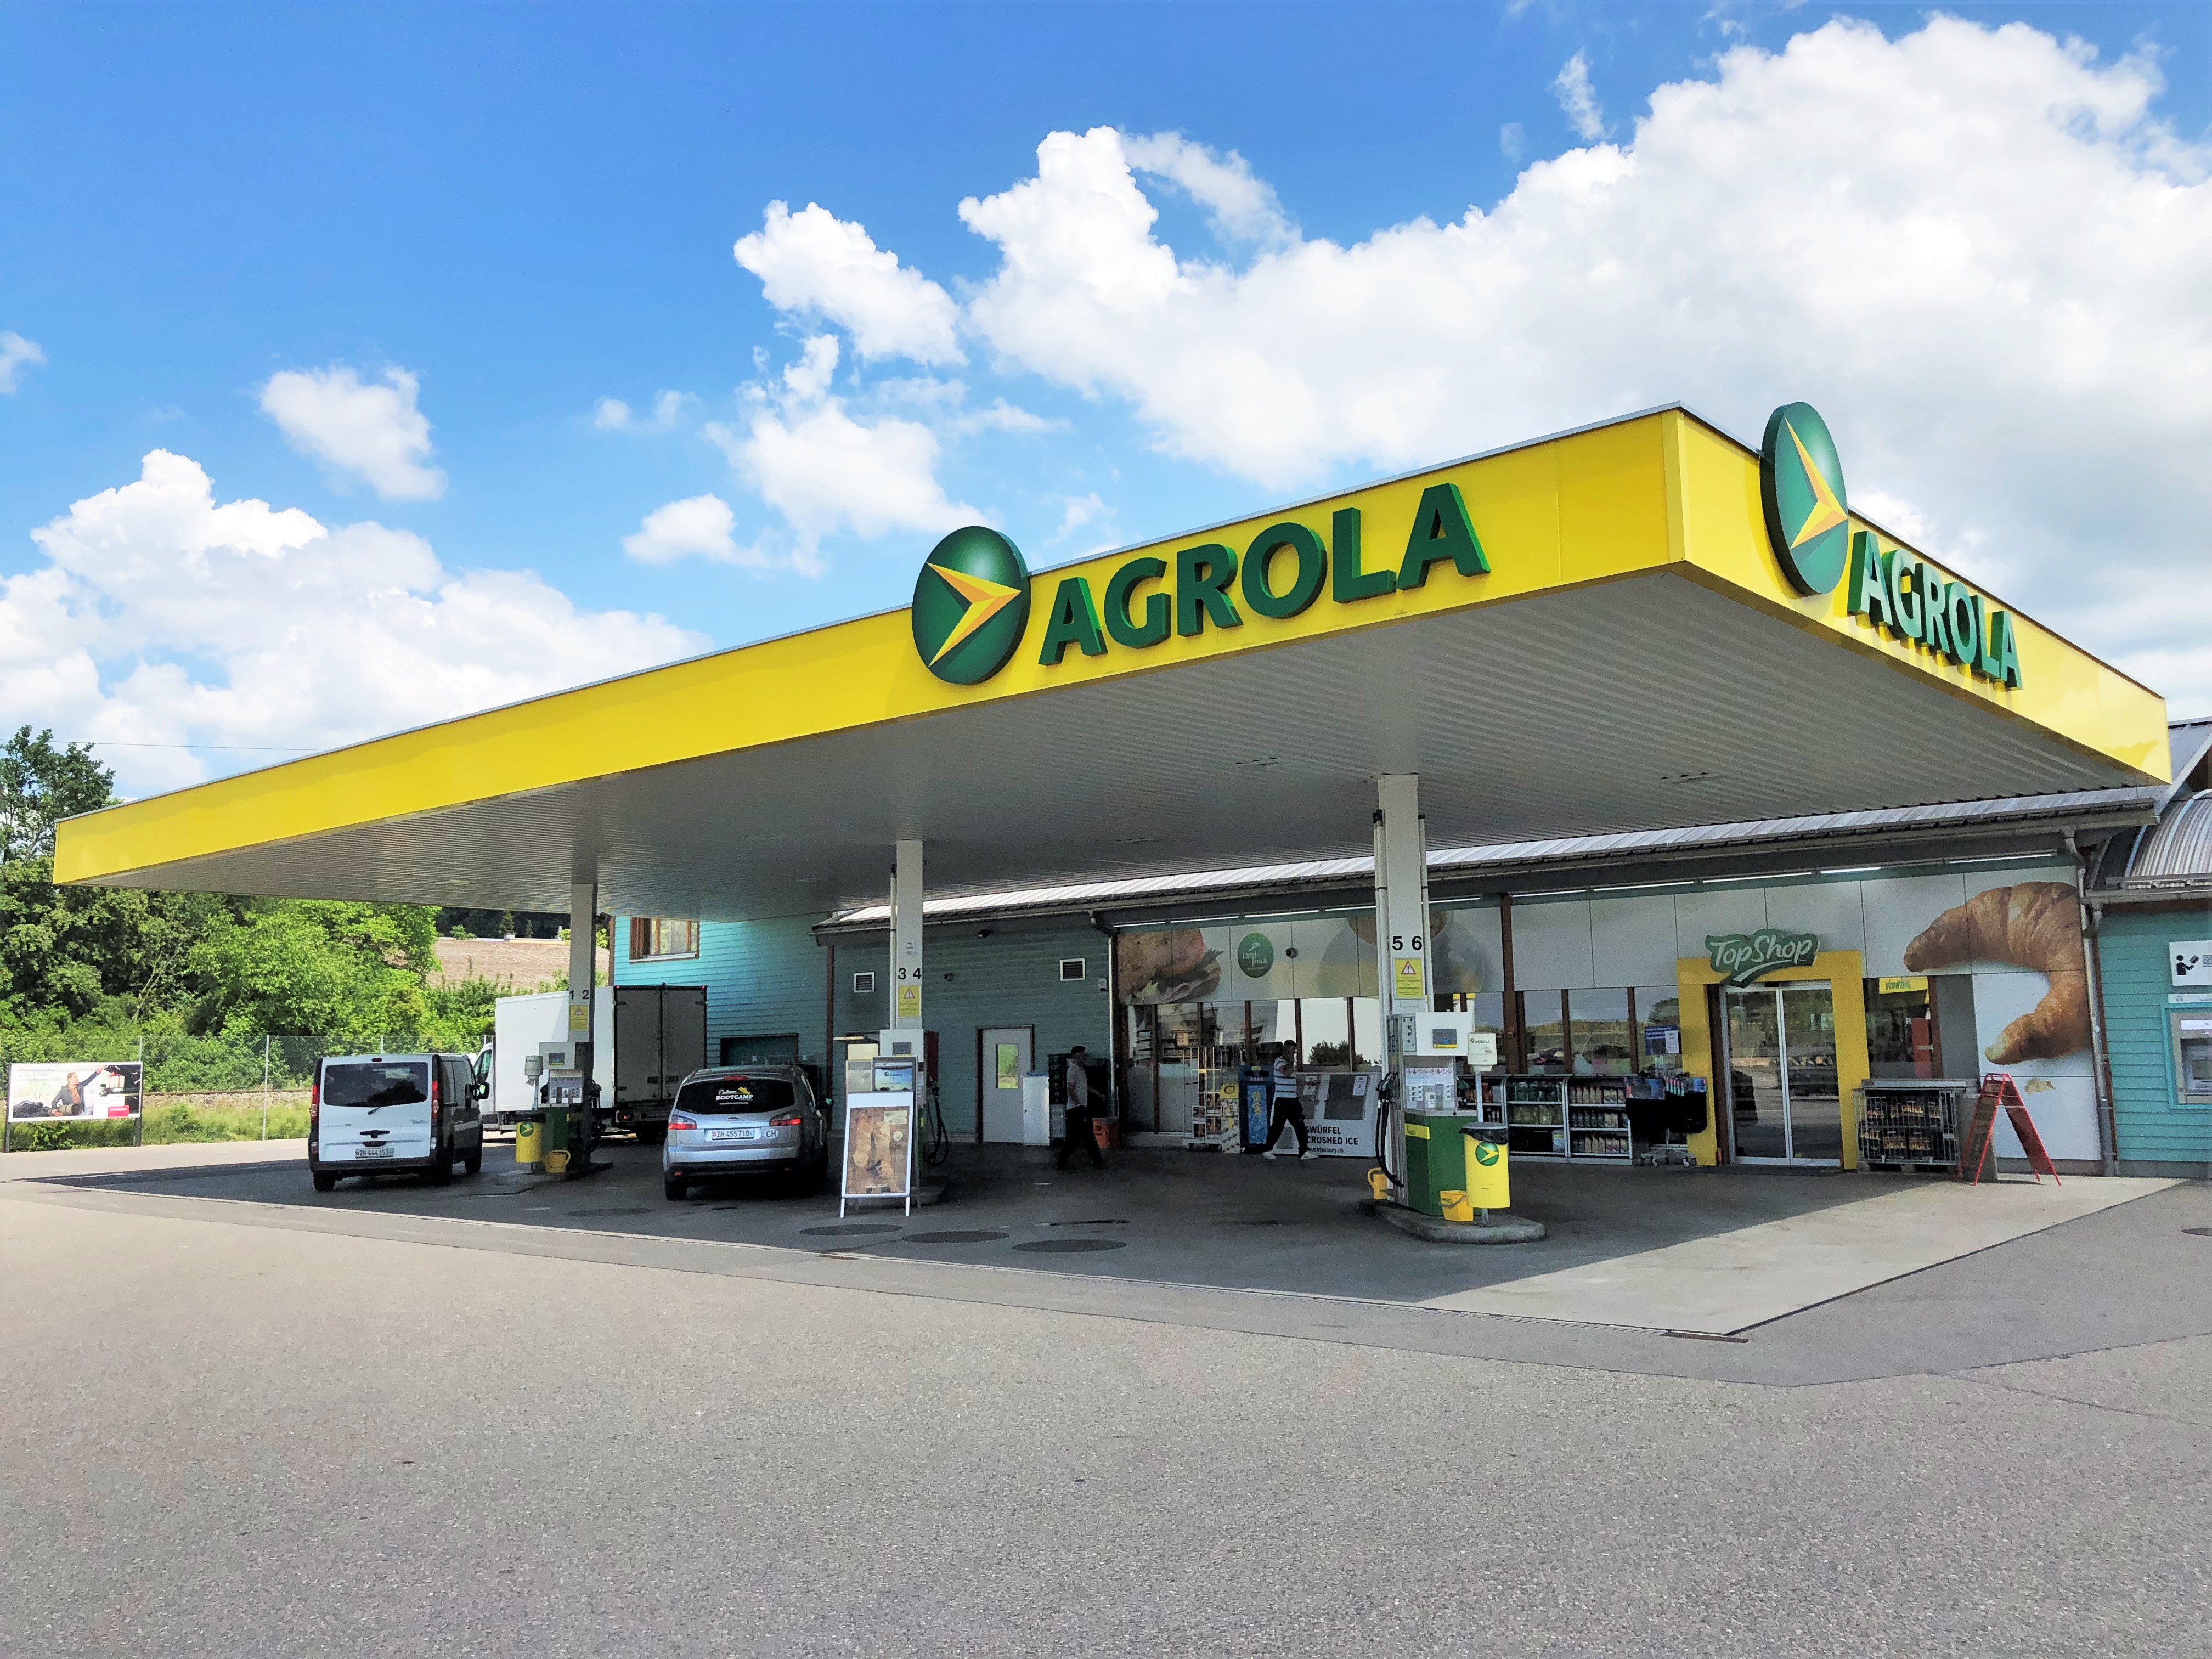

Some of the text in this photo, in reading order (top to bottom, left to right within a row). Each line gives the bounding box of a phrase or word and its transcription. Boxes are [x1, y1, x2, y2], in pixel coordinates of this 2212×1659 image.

[1038, 483, 1491, 666] AGROLA
[1848, 531, 2023, 690] AGROLA
[1392, 935, 1423, 951] 5 6
[898, 968, 922, 980] 3 4
[569, 990, 590, 1000] 1 2
[1306, 1125, 1341, 1135] SWÜRFEL
[1307, 1136, 1343, 1144] CRUSHED
